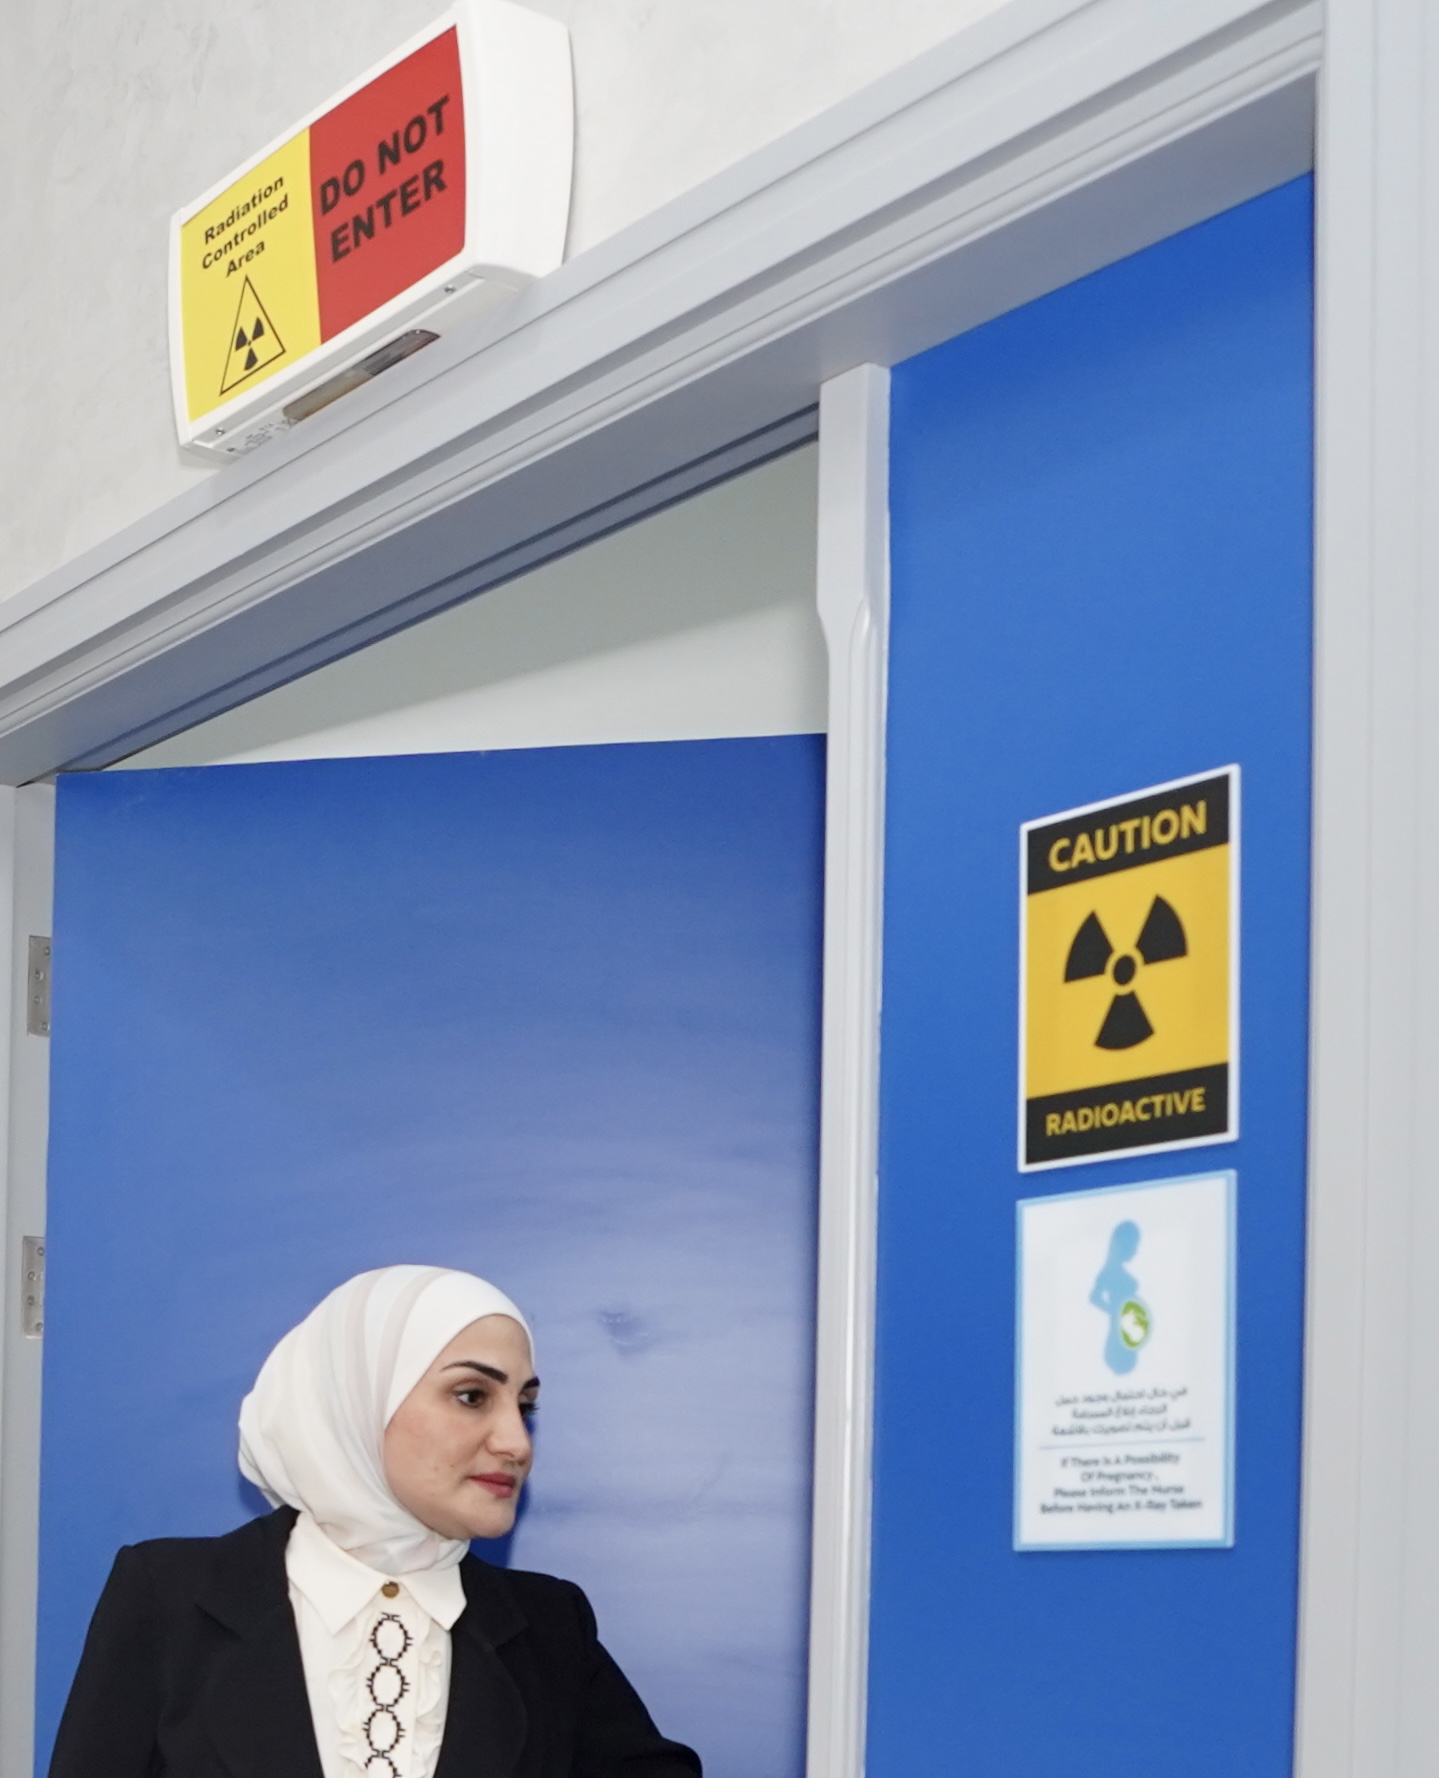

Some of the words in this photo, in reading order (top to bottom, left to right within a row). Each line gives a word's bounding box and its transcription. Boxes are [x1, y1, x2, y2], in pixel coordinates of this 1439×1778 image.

[320, 159, 365, 217] DO
[377, 94, 451, 176] NOT
[201, 192, 289, 270] Controlled
[204, 175, 284, 246] Radiation
[330, 159, 447, 264] ENTER
[226, 240, 266, 279] Area
[1048, 799, 1208, 873] CAUTION
[1045, 1087, 1206, 1137] RADIOACTIVE
[1125, 1452, 1180, 1467] Possibility
